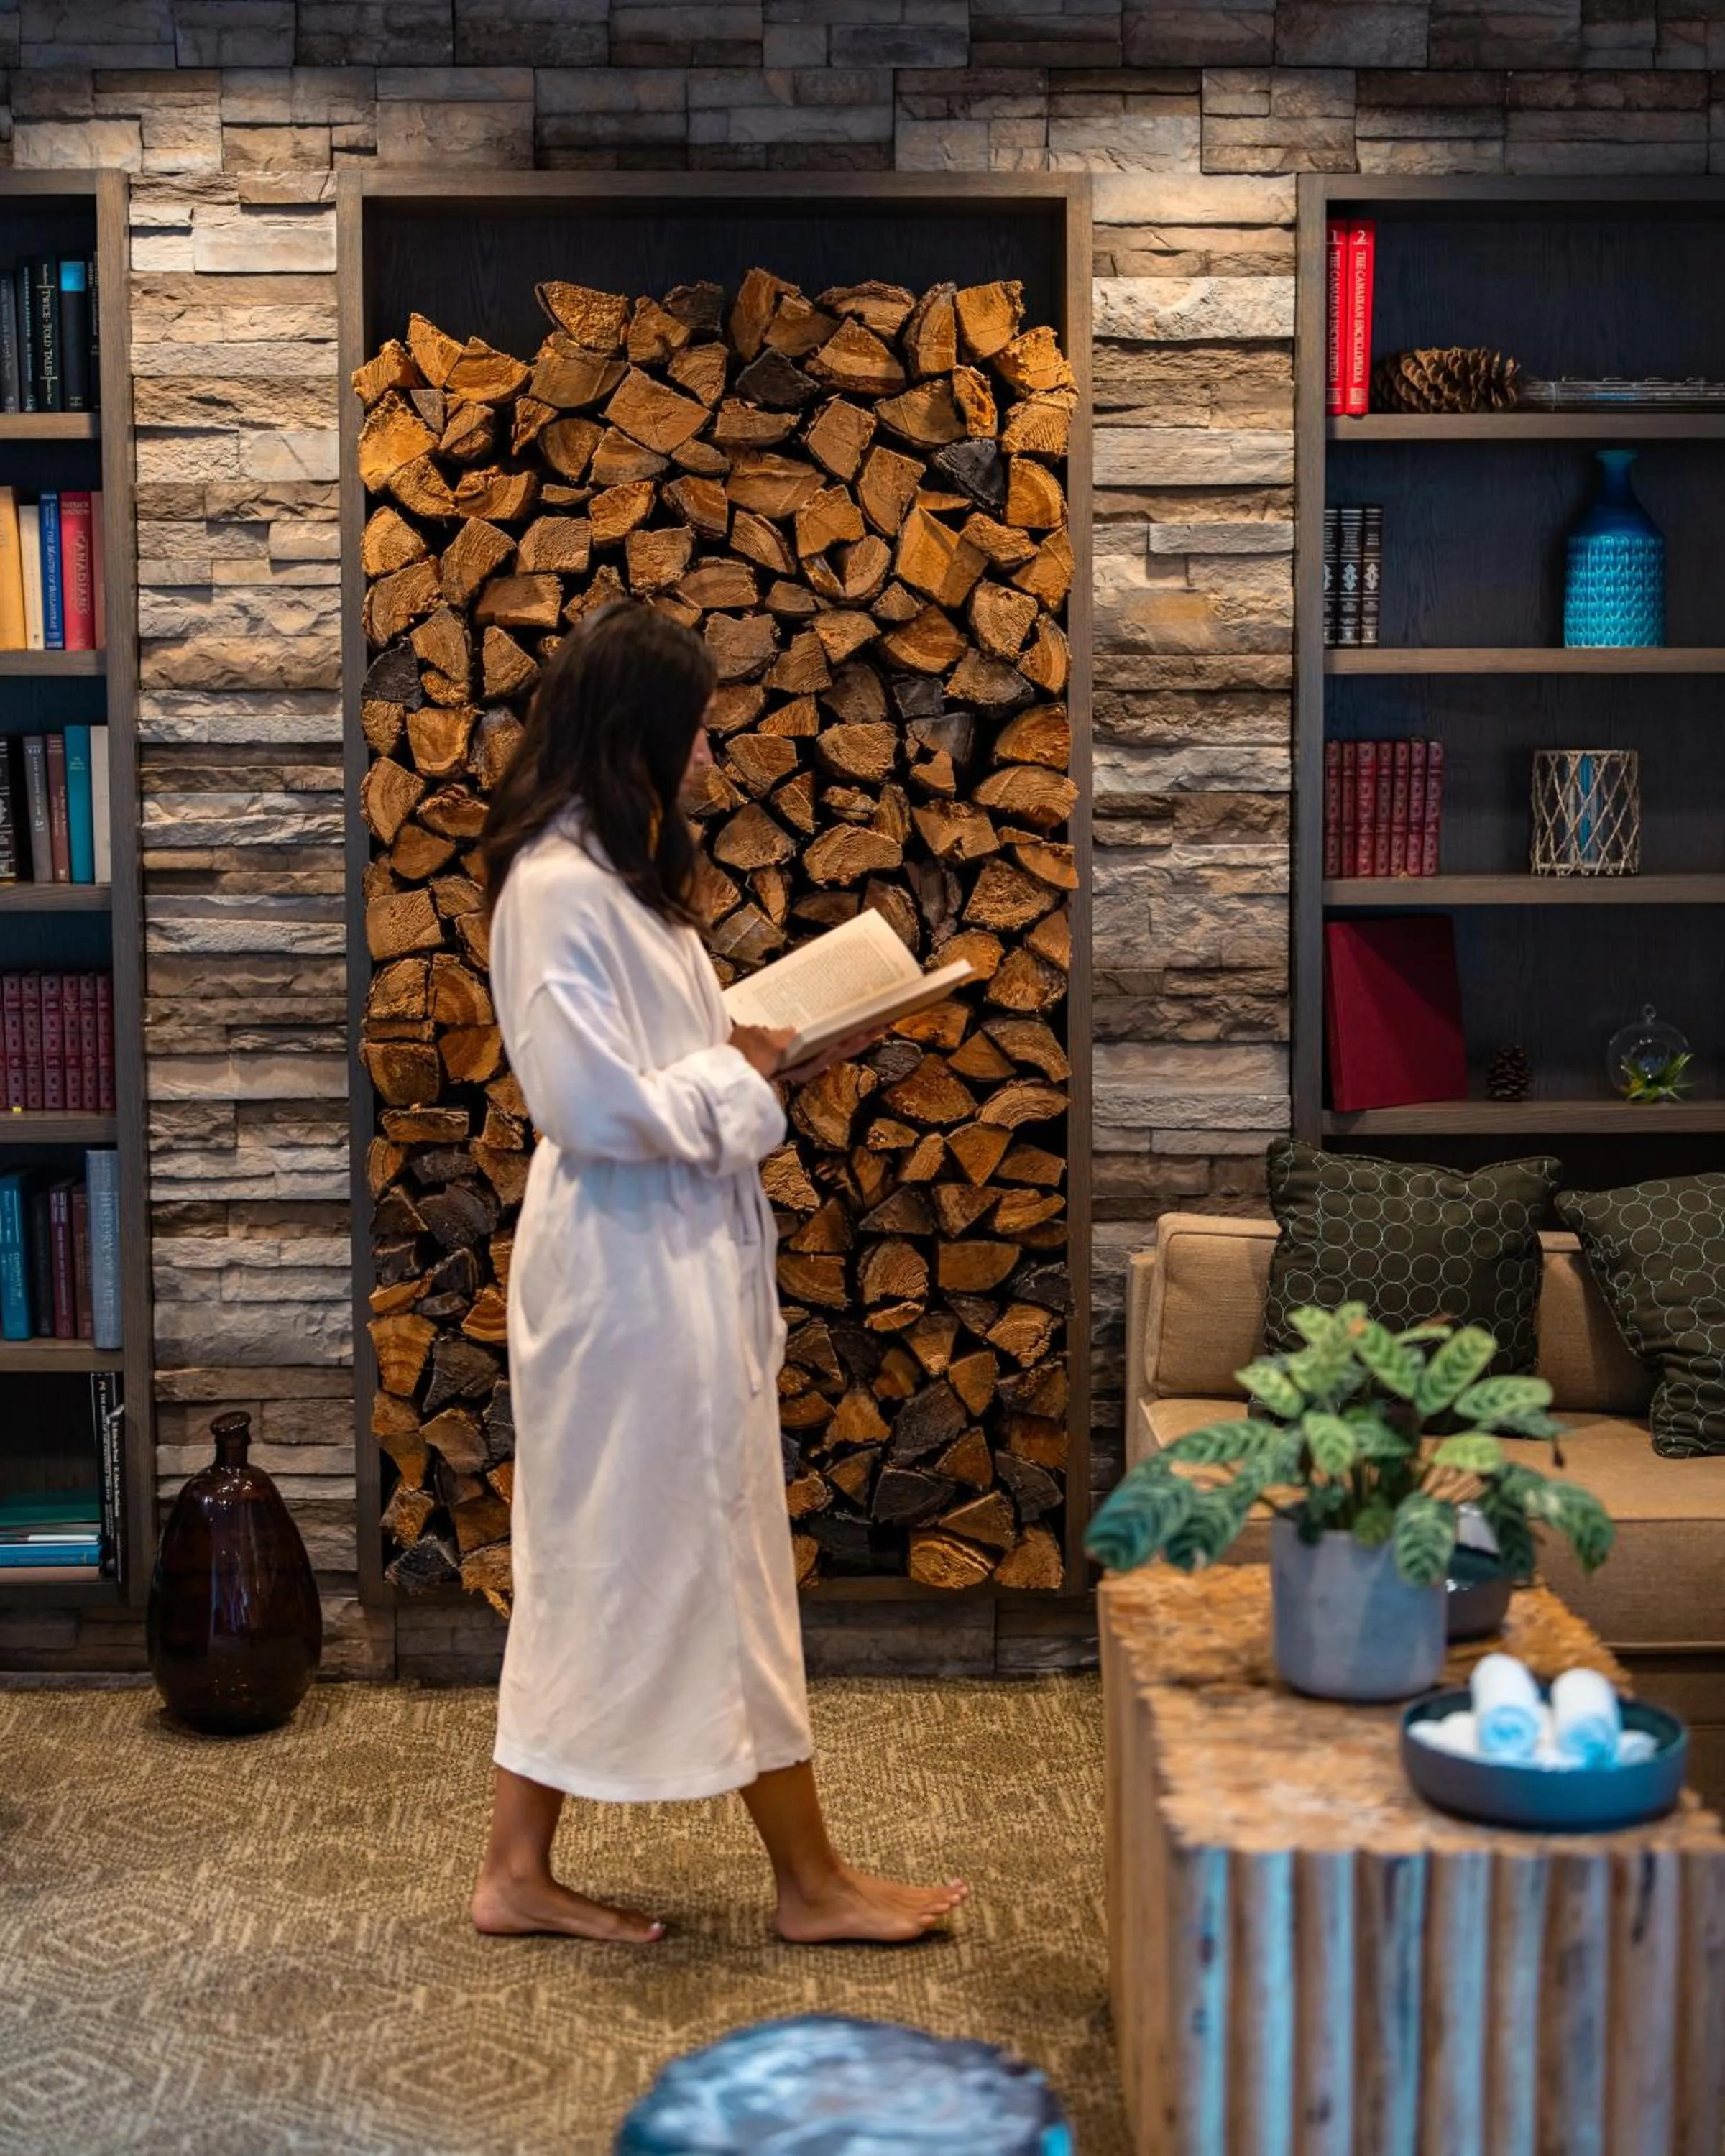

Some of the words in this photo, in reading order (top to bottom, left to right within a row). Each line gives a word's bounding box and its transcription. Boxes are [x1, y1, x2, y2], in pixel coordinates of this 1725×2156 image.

[1332, 230, 1338, 242] 1
[1357, 230, 1366, 242] 2
[1356, 251, 1366, 270] THE
[44, 349, 52, 377] TALES
